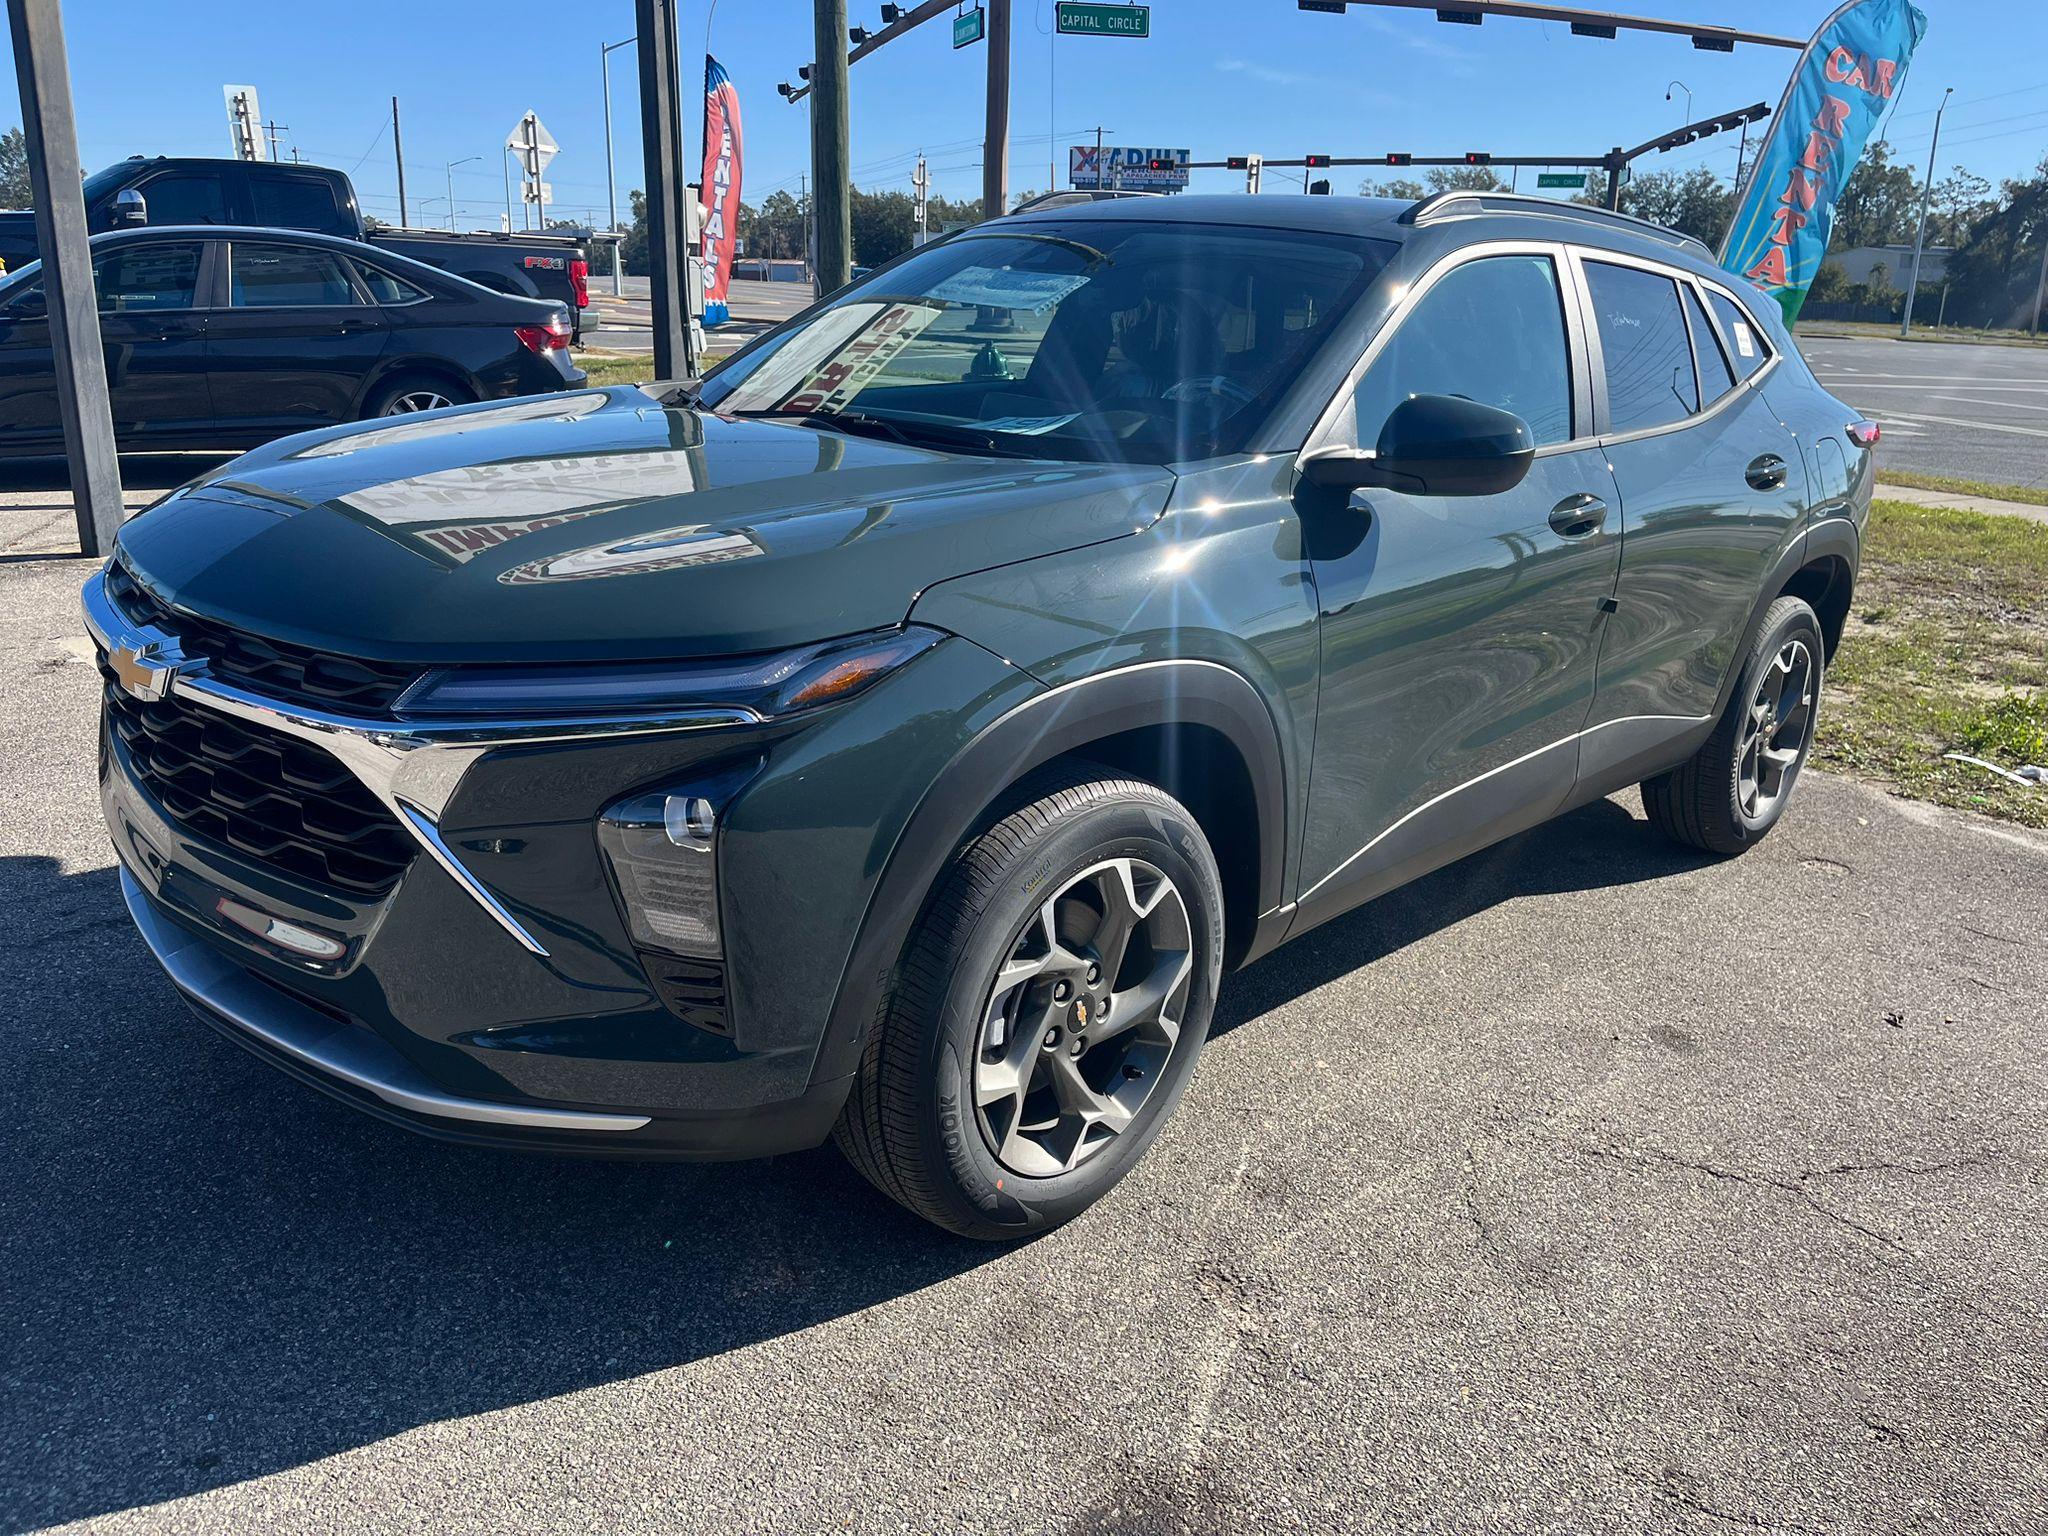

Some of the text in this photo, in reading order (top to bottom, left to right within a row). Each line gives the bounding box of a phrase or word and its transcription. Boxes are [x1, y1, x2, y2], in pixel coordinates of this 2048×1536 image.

[1061, 14, 1141, 30] CAPITAL CIRCLE
[1825, 45, 1897, 99] CAR
[1745, 94, 1851, 291] RENTA
[524, 256, 565, 270] FX4
